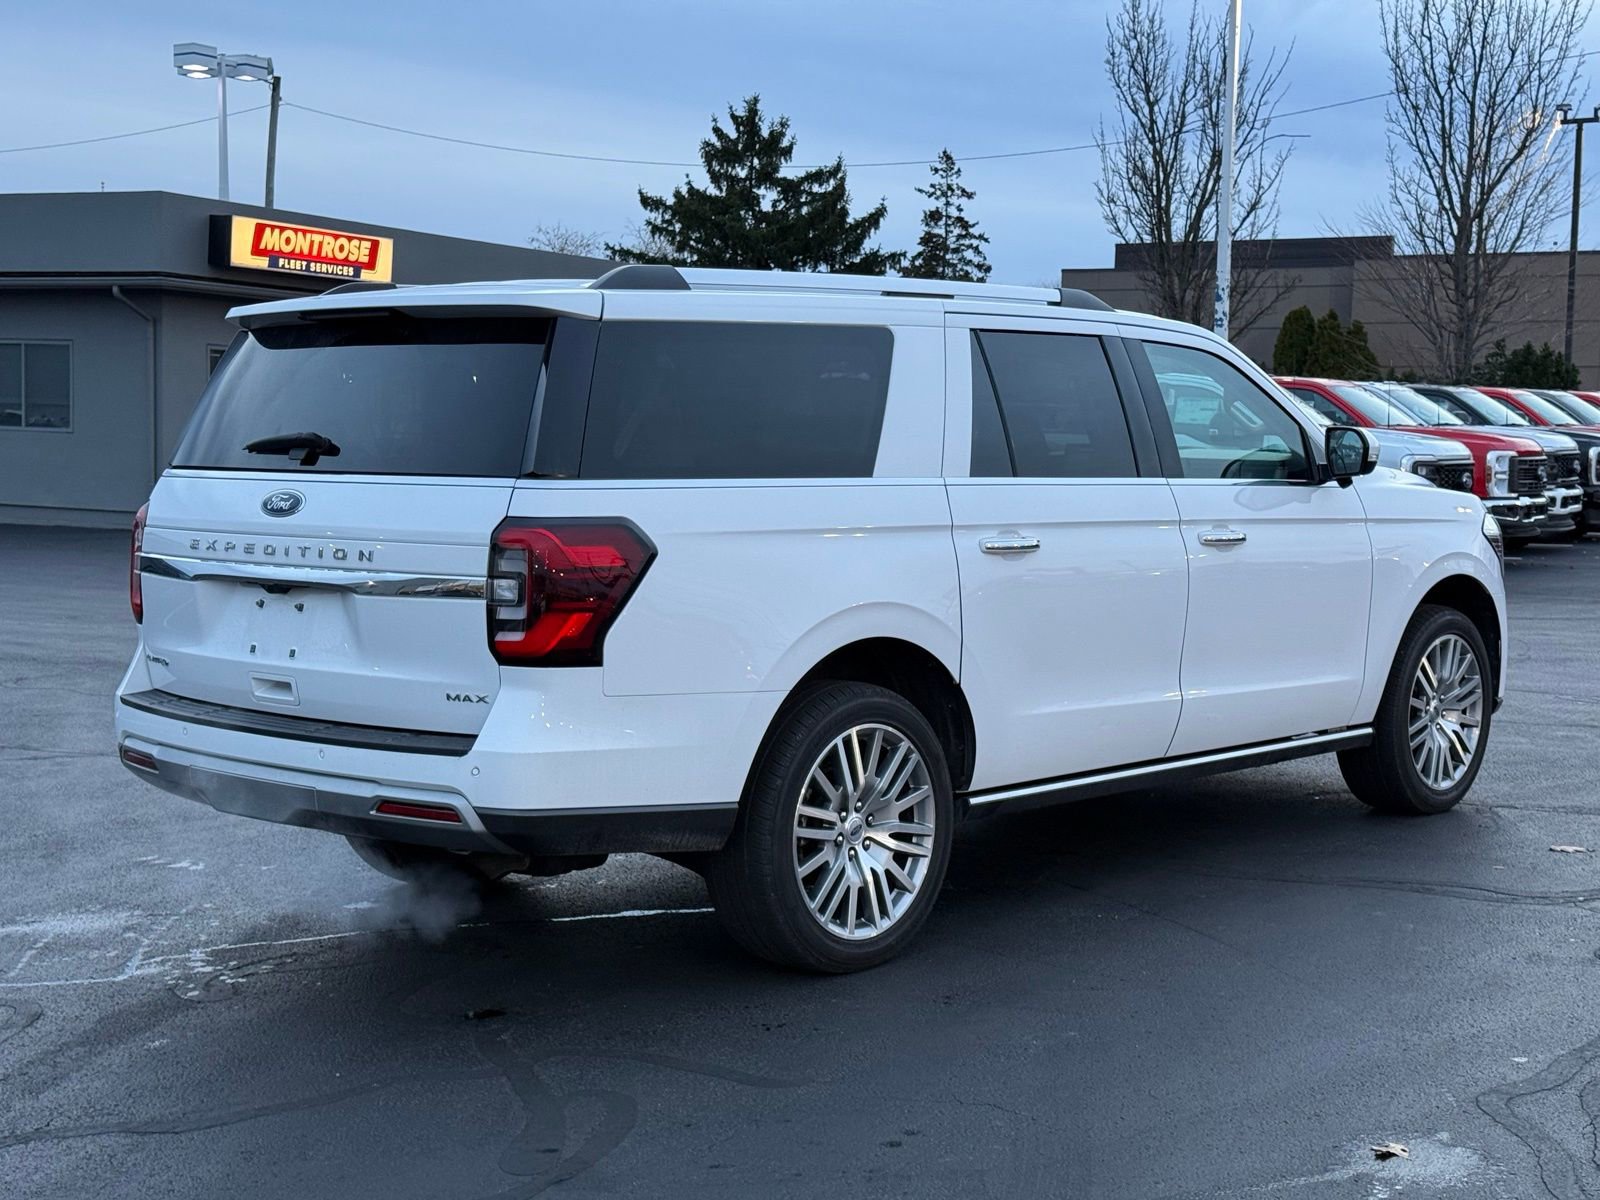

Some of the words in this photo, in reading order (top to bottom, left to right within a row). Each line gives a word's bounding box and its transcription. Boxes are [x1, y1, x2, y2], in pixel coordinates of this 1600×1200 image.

[259, 226, 372, 264] MONTROSE
[278, 258, 307, 271] FLEET
[309, 262, 354, 276] SERVICES
[267, 494, 294, 510] Ford
[189, 537, 376, 564] EXPEDITION
[445, 692, 490, 705] MAX
